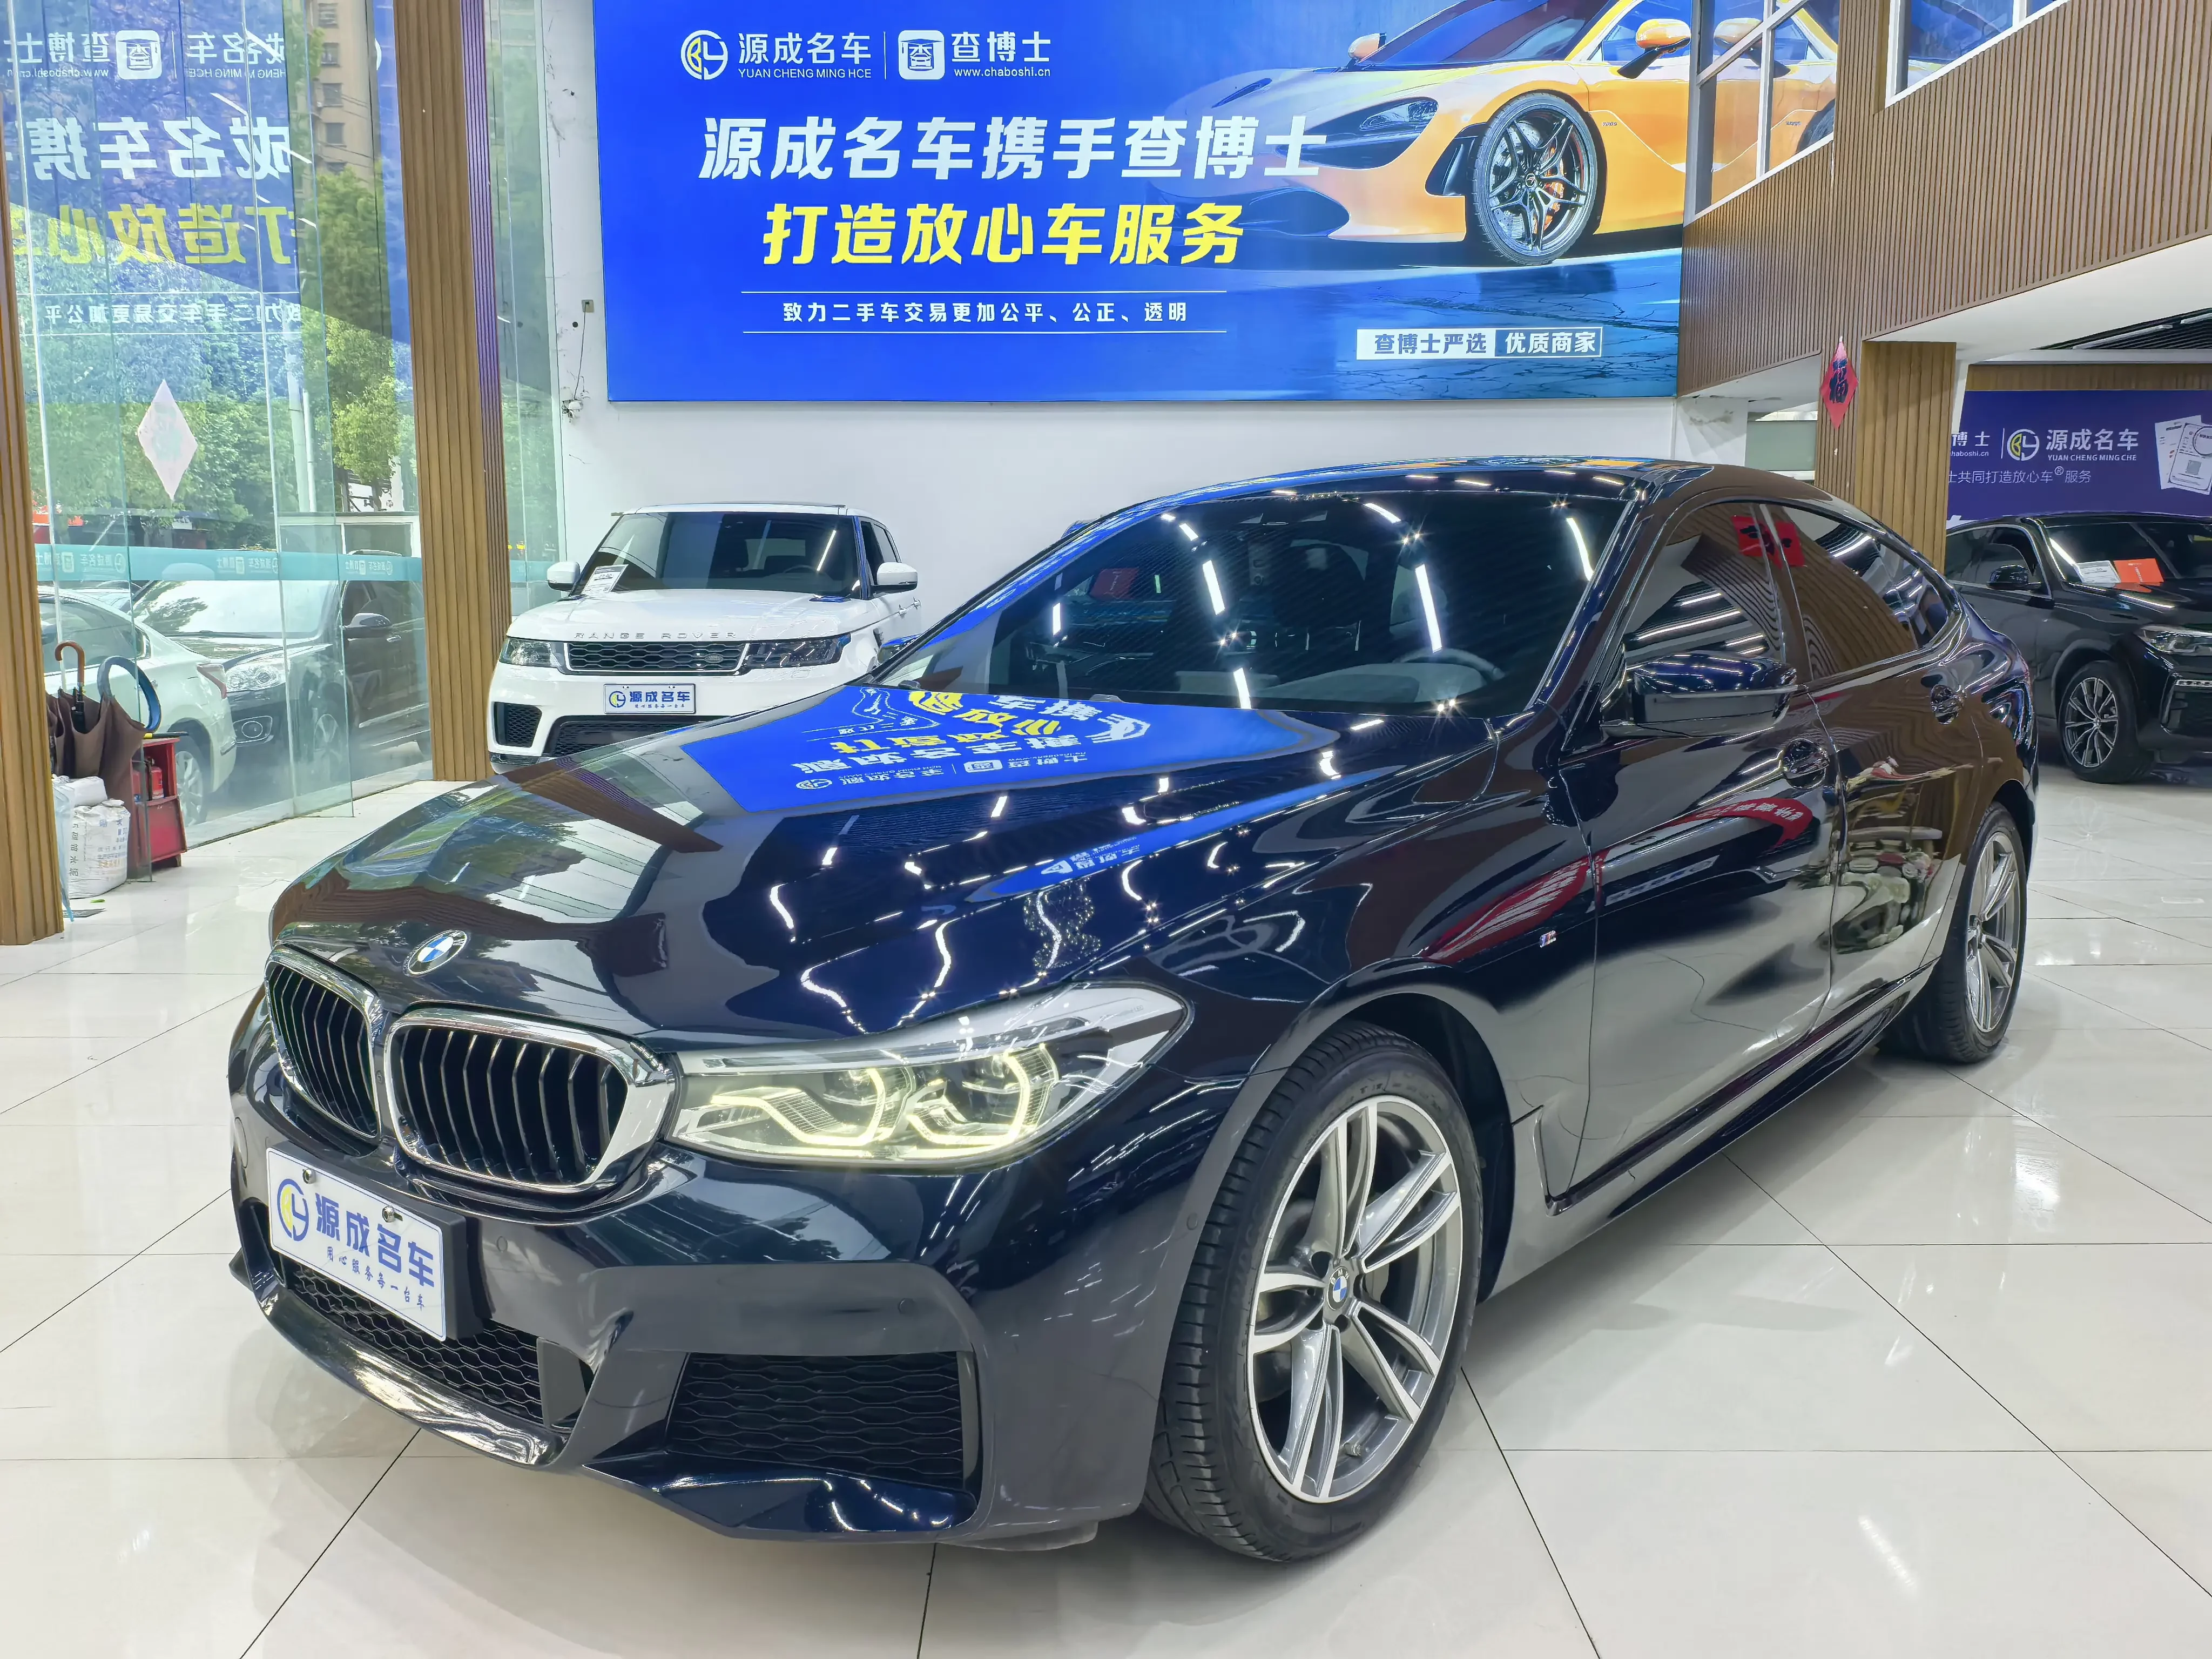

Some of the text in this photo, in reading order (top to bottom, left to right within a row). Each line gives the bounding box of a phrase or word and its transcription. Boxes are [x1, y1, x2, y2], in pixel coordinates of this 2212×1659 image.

[738, 32, 871, 64] 源成名车
[951, 31, 1050, 63] 查博士
[738, 69, 871, 78] YUAN CHENG MING HCE
[954, 68, 1050, 77] www.chaboshi.cn
[698, 116, 1327, 180] 源成名车携手查博士
[763, 203, 1243, 265] 打造放心车服务
[783, 301, 1188, 324] 致力二手车交易更加公平、公正、透明
[1374, 331, 1596, 354] 查博士严选 优质商家
[2046, 429, 2139, 451] 源成名车
[629, 691, 690, 702] 源成名车
[315, 1192, 434, 1287] 源成名车
